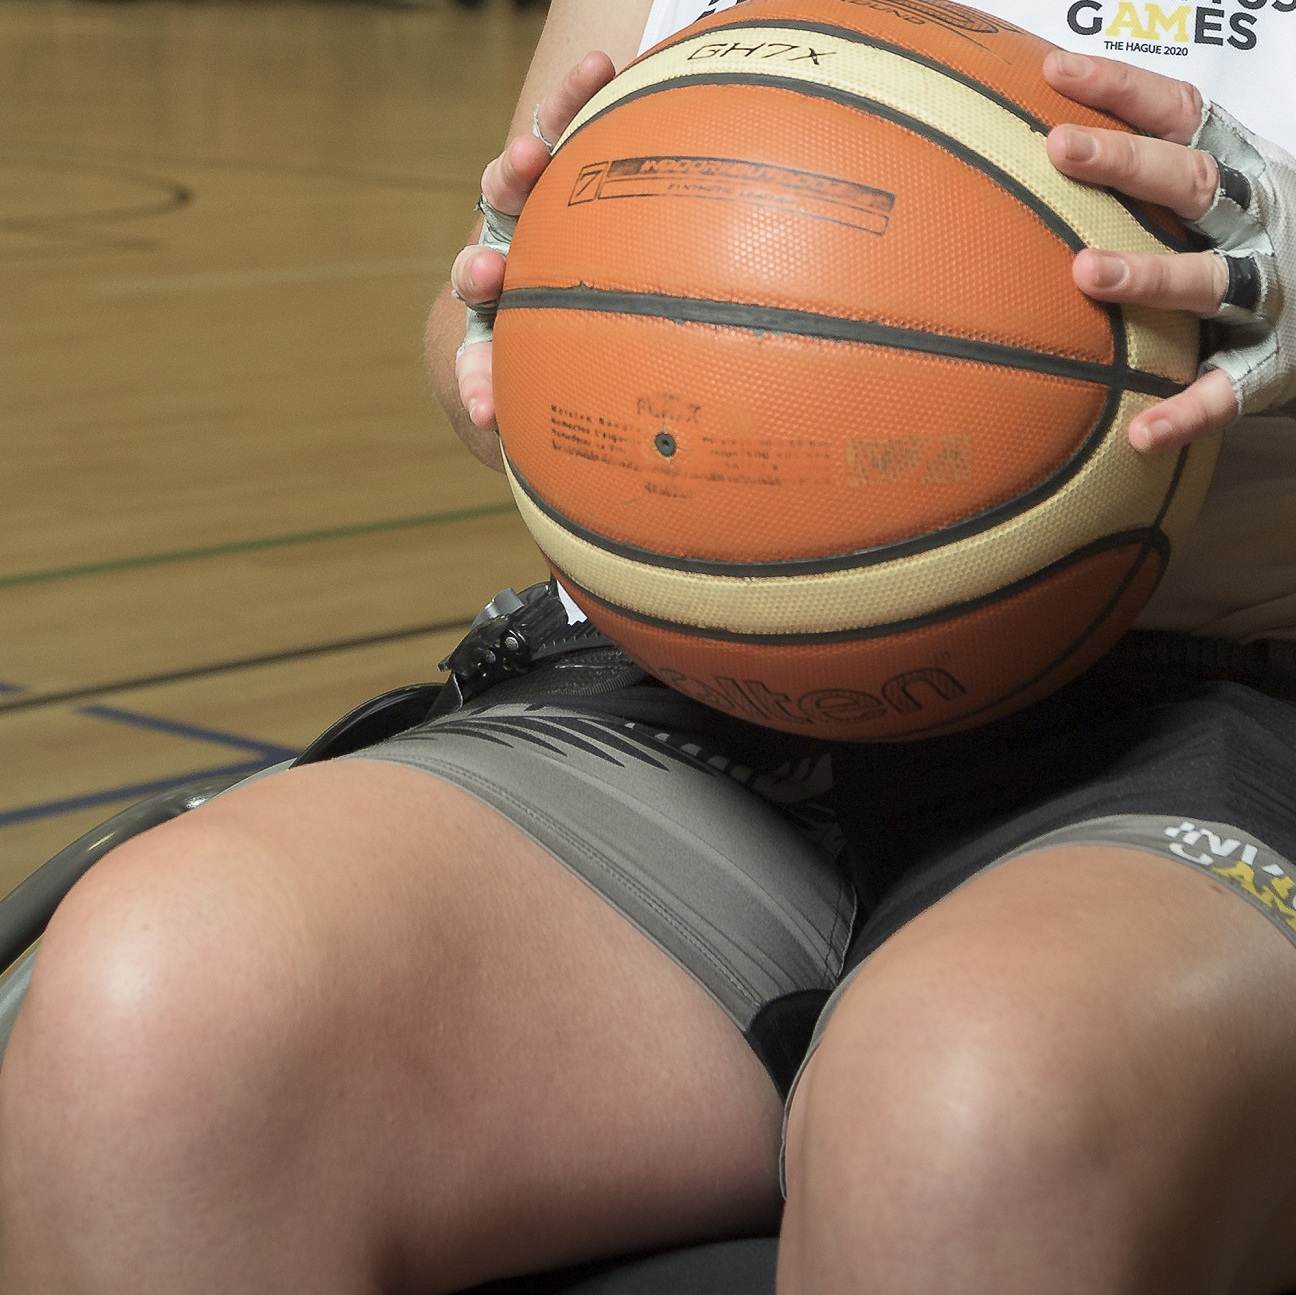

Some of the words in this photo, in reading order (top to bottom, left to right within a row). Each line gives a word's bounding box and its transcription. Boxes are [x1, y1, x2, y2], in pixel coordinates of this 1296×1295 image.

[1066, 0, 1258, 51] GAMES
[687, 42, 837, 66] GH7X
[1103, 40, 1124, 51] THE
[1125, 42, 1162, 55] HAGUE
[1163, 46, 1189, 57] 2020
[575, 169, 602, 198] 7
[658, 667, 968, 724] olten
